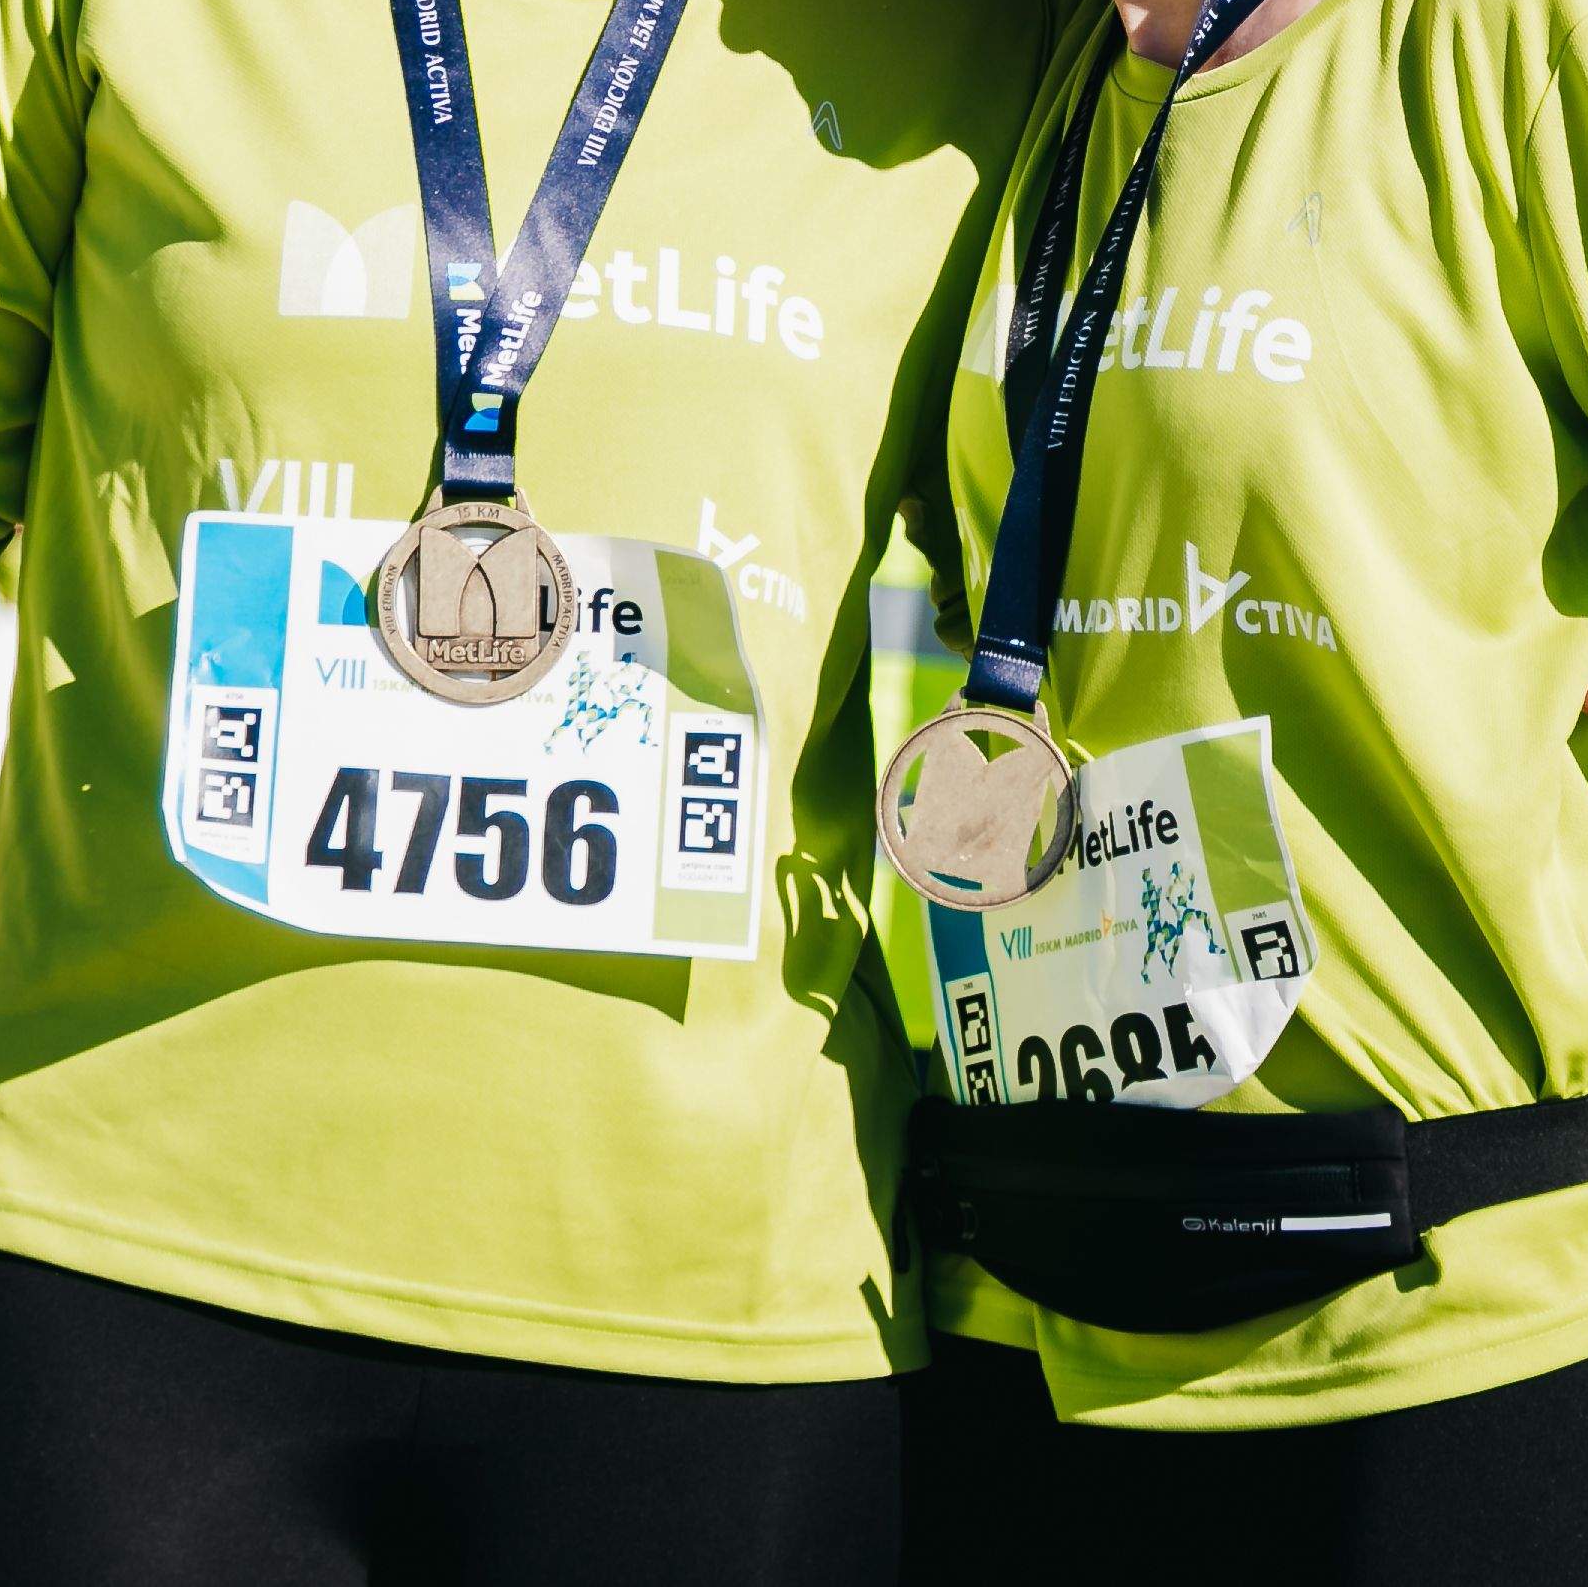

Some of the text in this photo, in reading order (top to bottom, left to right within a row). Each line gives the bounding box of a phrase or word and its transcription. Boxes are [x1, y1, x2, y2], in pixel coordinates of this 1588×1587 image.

[1193, 8, 1220, 47] 15K
[424, 53, 453, 125] ACTIVA
[576, 132, 608, 167] VIII
[594, 53, 640, 135] EDICIÓN
[629, 12, 658, 51] 15K
[560, 247, 825, 360] etLife
[480, 290, 543, 387] MetLife
[1047, 411, 1070, 451] VIII
[1059, 310, 1098, 404] EDICIÓN
[1092, 260, 1113, 296] 15K
[477, 507, 500, 520] KM
[552, 554, 573, 603] MADRID
[1052, 596, 1183, 634] MADRID
[315, 657, 366, 690] VIII
[426, 639, 526, 665] MetLife
[305, 767, 620, 906] 4756
[1000, 924, 1032, 960] VIII
[1035, 940, 1062, 956] 15KM
[1064, 928, 1102, 948] MADRID
[1208, 1217, 1276, 1236] Kalenji
